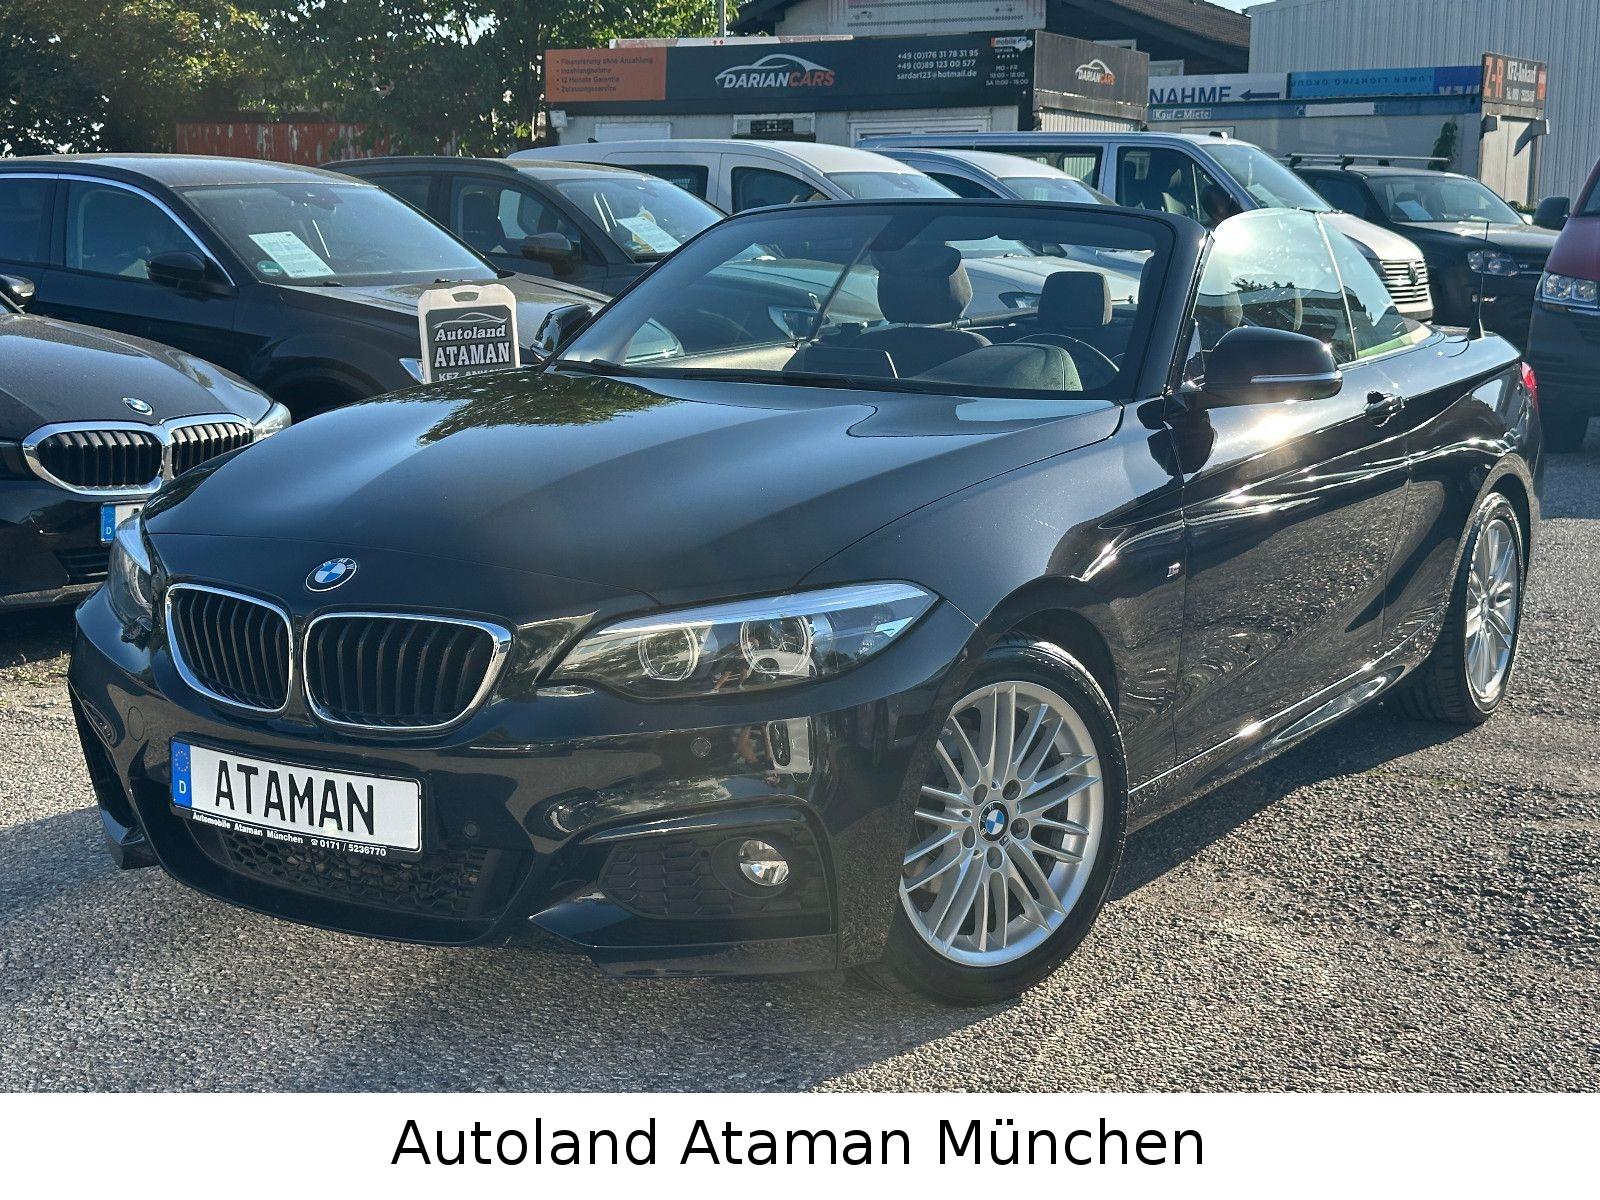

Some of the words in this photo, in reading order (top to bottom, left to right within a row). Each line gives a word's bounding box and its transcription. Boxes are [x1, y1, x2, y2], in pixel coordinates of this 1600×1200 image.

[434, 325, 506, 342] Autoland
[434, 342, 510, 368] ATAMAN
[106, 526, 112, 535] D
[179, 780, 187, 794] D
[215, 759, 375, 836] ATAMAN
[192, 811, 231, 829] Automobile
[234, 823, 263, 837] Ataman
[266, 829, 304, 844] München
[320, 839, 340, 850] 0171
[348, 843, 387, 857] 5236770
